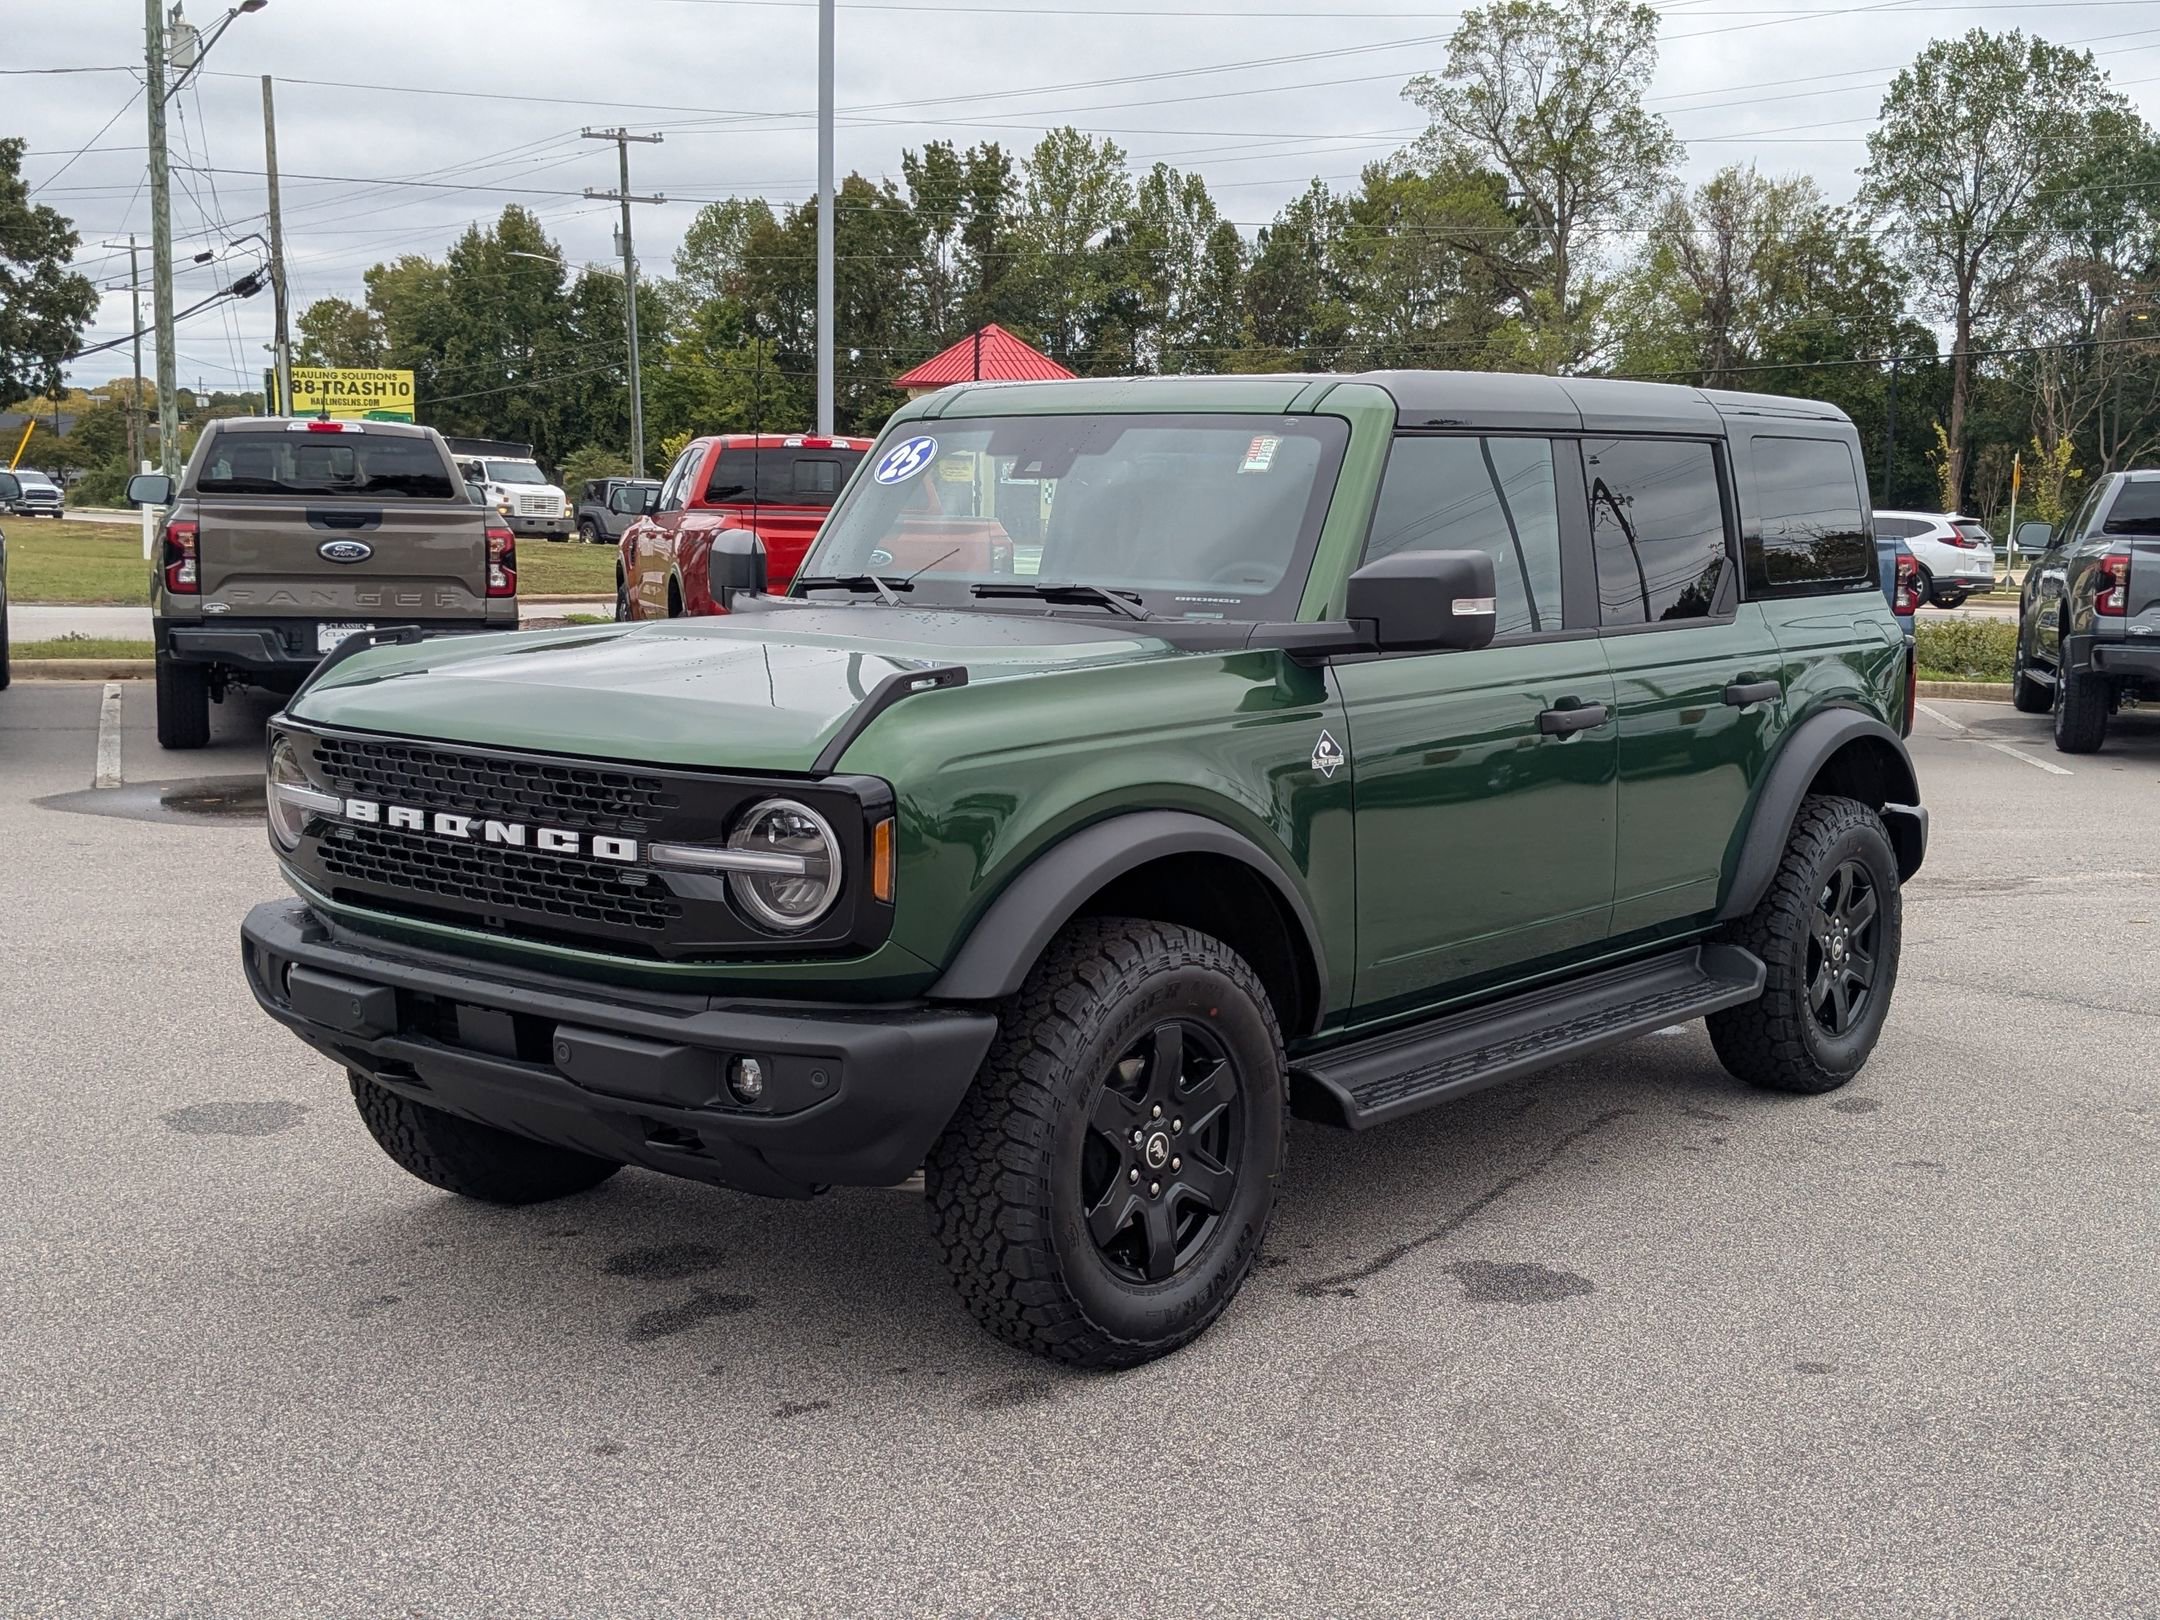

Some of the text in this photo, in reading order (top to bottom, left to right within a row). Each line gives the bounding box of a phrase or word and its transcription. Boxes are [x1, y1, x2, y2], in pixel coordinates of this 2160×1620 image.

[292, 370, 398, 381] HAULING SOLUTIONS
[879, 440, 932, 481] 25
[226, 589, 464, 607] RANGER
[1175, 596, 1241, 604] BRONCO
[346, 799, 637, 862] BRONCO
